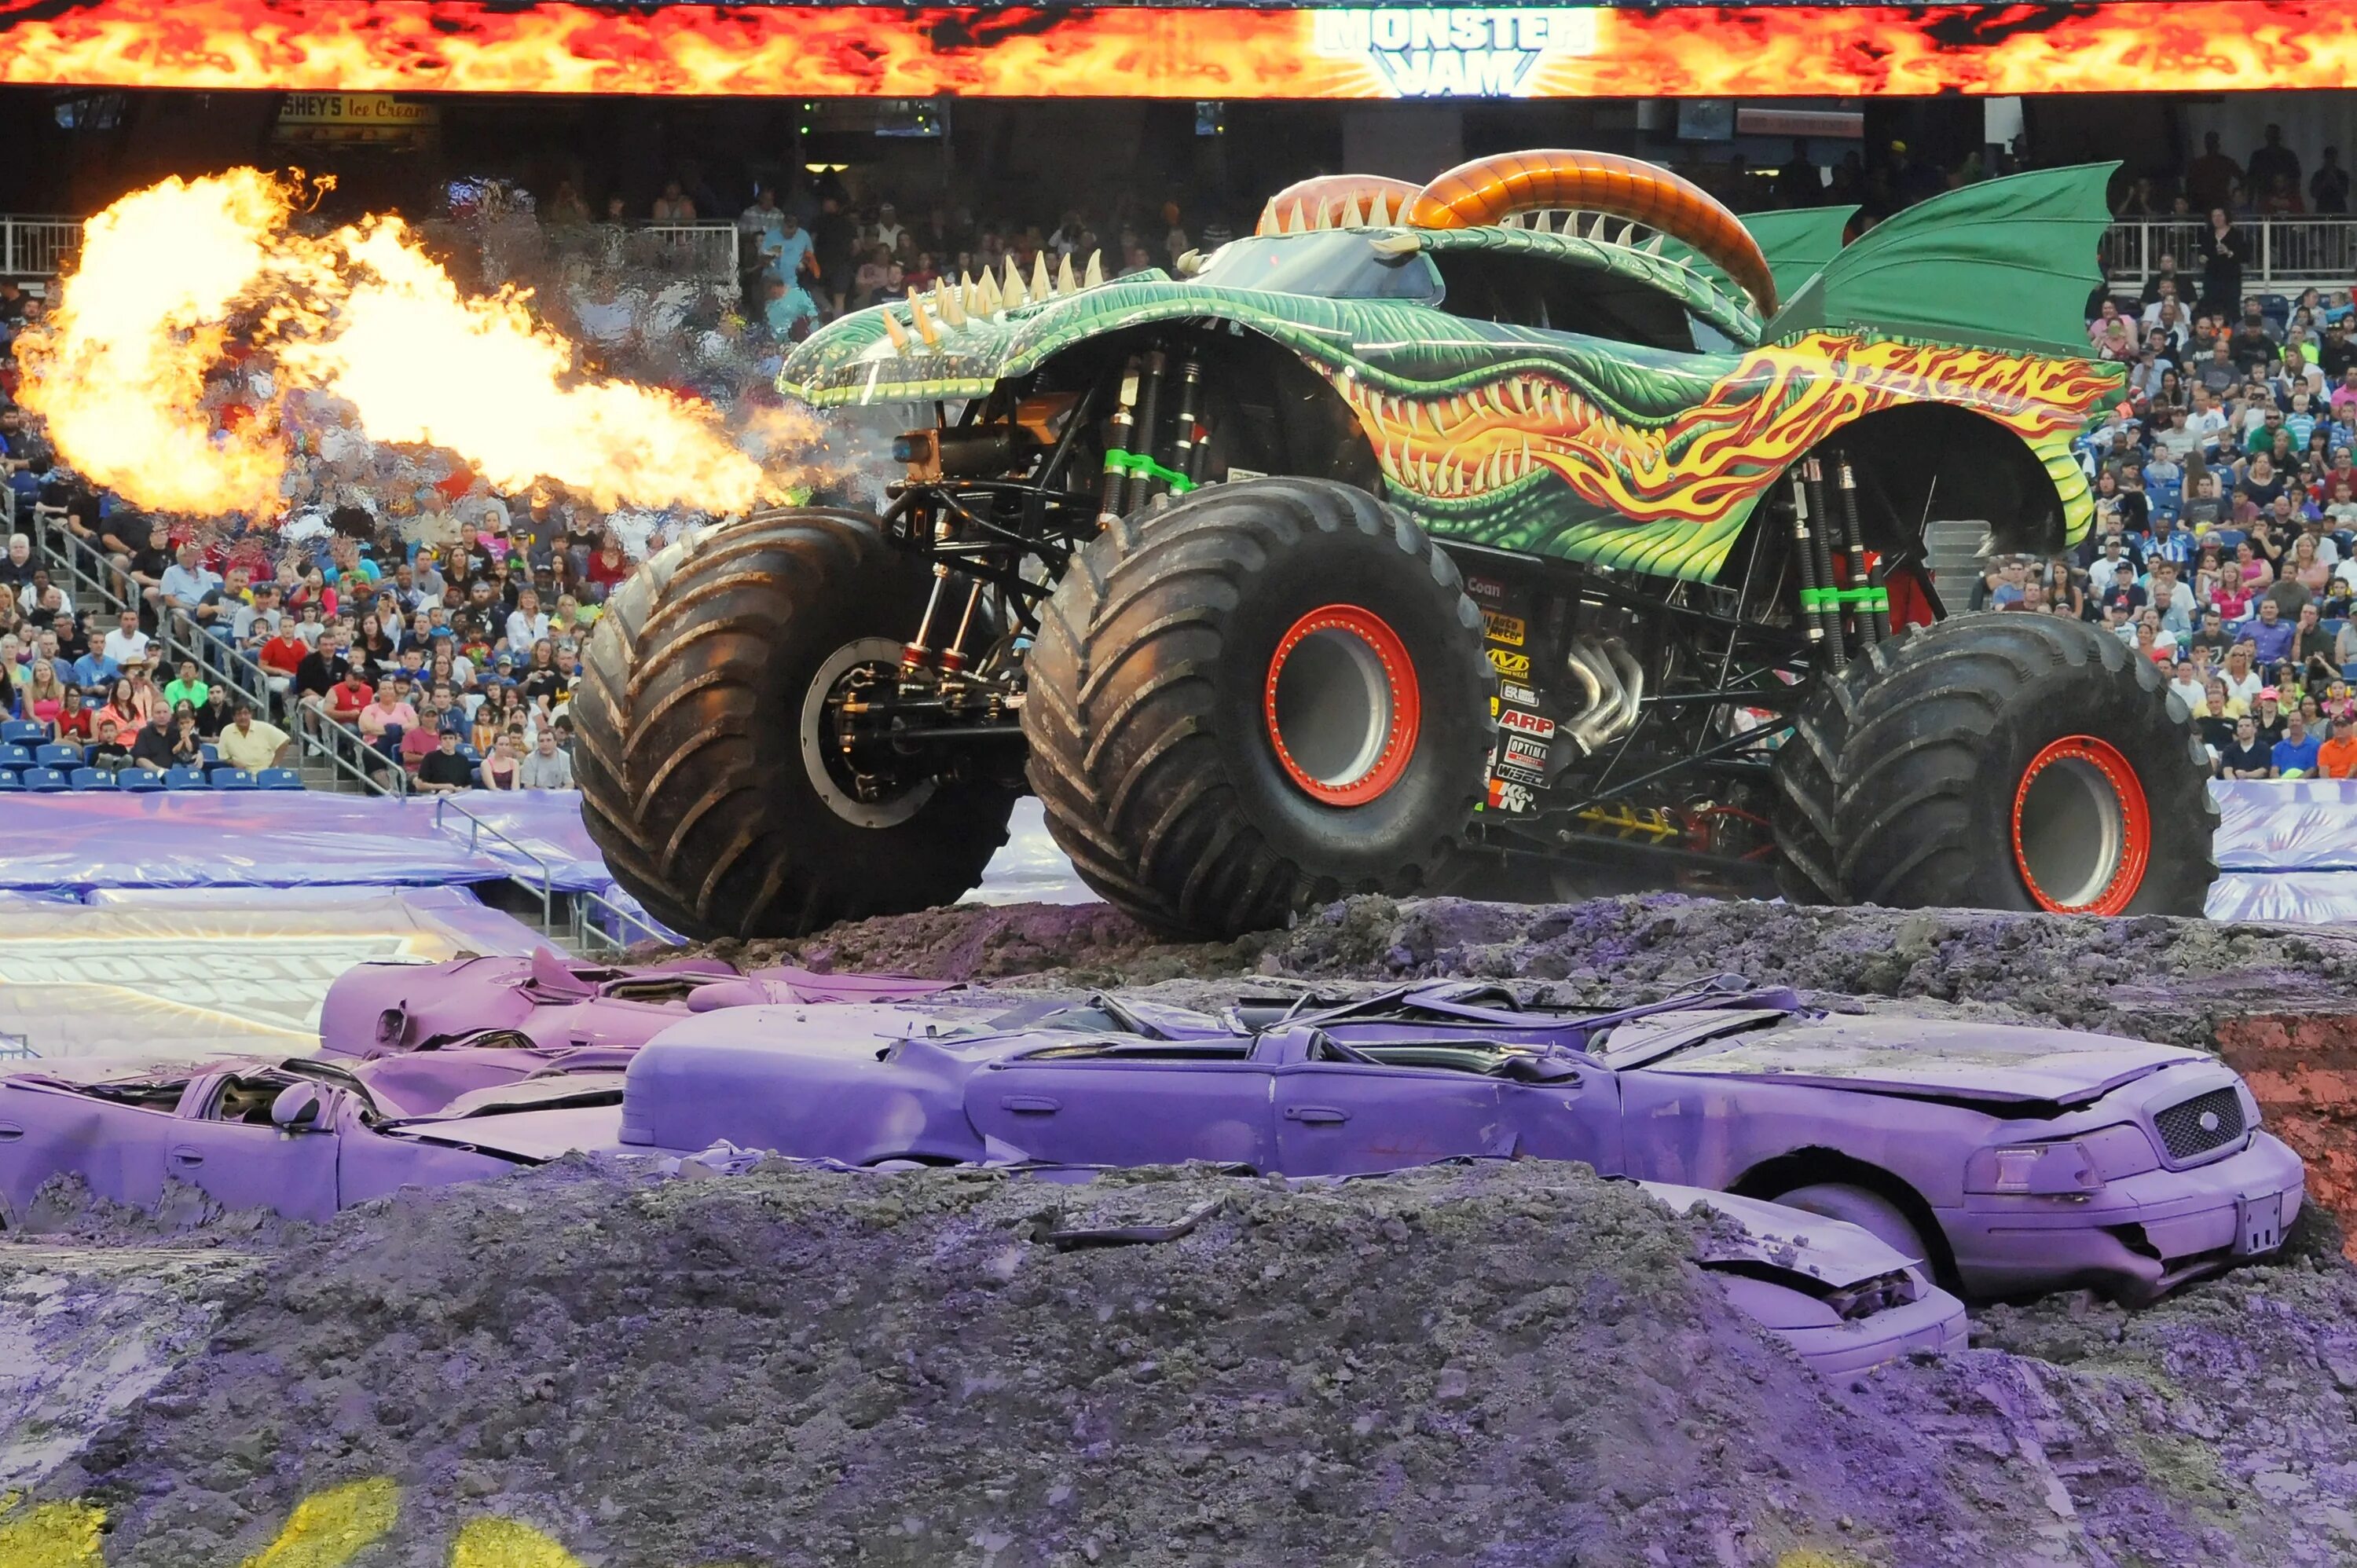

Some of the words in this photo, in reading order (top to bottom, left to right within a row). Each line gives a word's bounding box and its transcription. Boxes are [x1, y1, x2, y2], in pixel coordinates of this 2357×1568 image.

[1321, 8, 1589, 50] MONSTER
[1380, 49, 1528, 97] JAM
[280, 96, 341, 116] SHEY'S
[349, 98, 369, 116] Ice
[1468, 577, 1501, 597] Coan
[1501, 711, 1553, 733] ARP
[1511, 740, 1547, 760] OPTIMA
[2, 954, 357, 982] MONST
